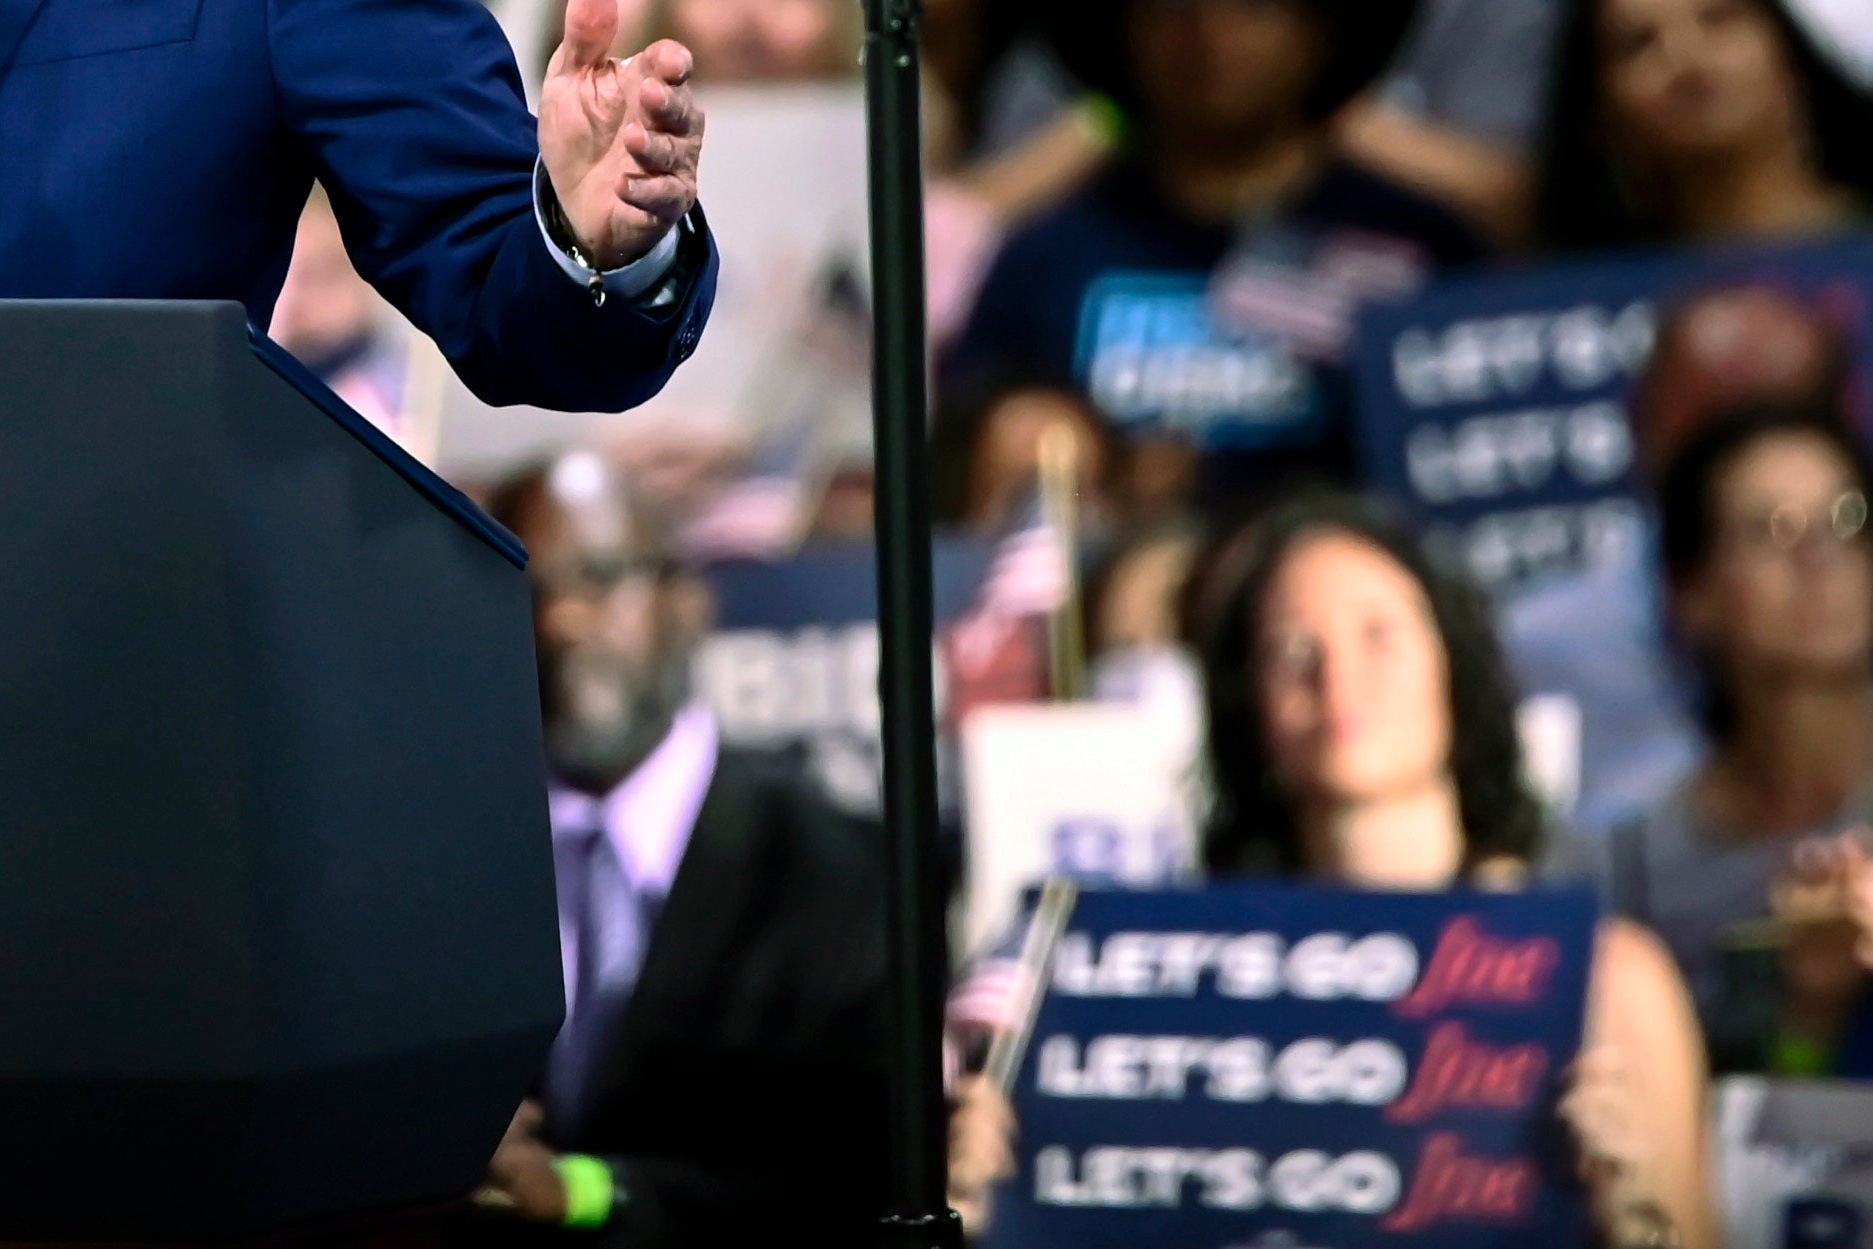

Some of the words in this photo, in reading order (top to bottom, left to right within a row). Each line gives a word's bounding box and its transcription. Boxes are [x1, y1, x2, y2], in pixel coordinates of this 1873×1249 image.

[1051, 930, 1283, 1002] LET'S
[1281, 930, 1420, 1002] GO
[1035, 1035, 1273, 1104] LET'S
[1271, 1036, 1408, 1107] GO
[1032, 1145, 1263, 1212] LET'S
[1263, 1147, 1403, 1215] GO
